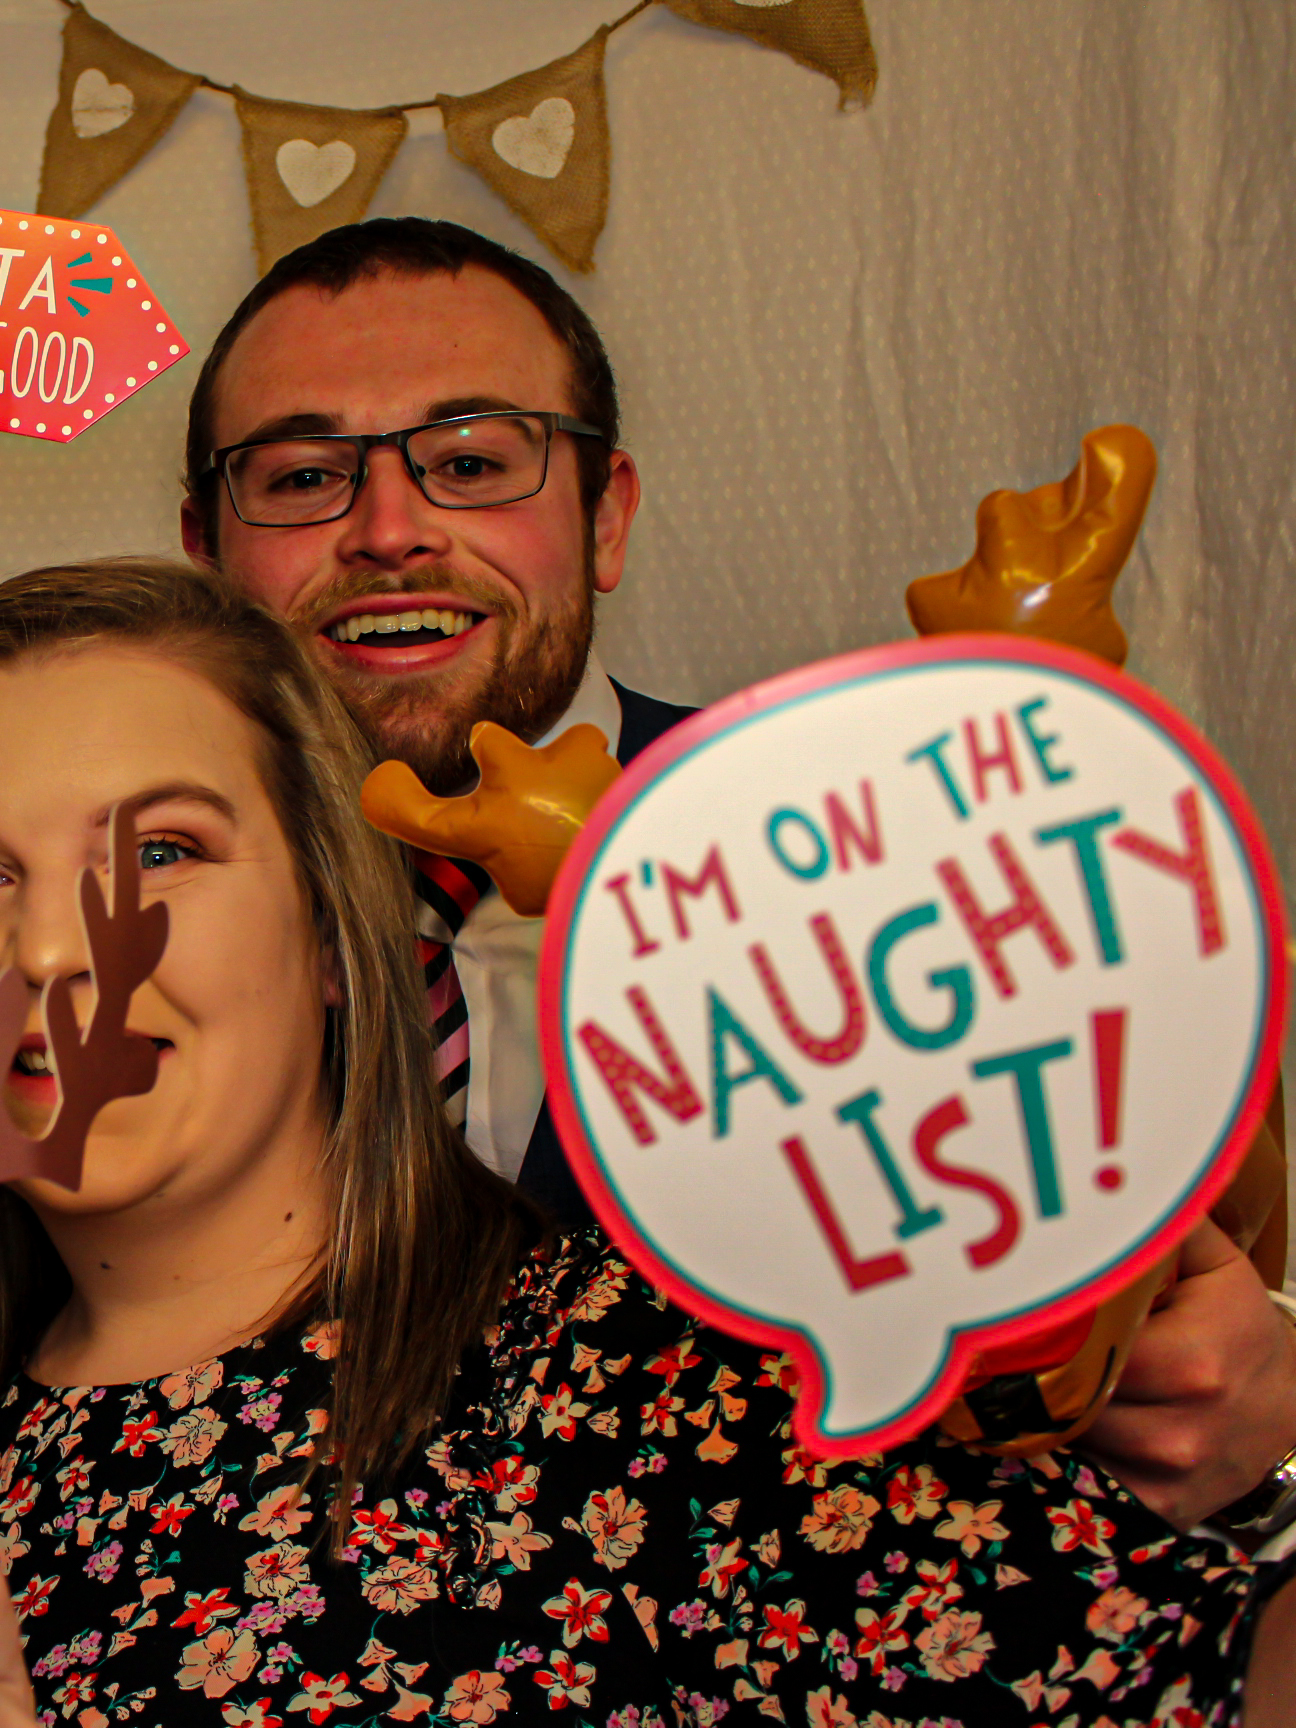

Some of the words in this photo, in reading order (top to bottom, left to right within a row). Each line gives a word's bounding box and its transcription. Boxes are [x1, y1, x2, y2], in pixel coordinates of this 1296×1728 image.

[576, 785, 1227, 1148] NAUGHTY
[604, 842, 741, 959] I'M
[764, 777, 885, 883] ON
[906, 696, 1075, 822] THE
[780, 1007, 1128, 1295] LIST!
